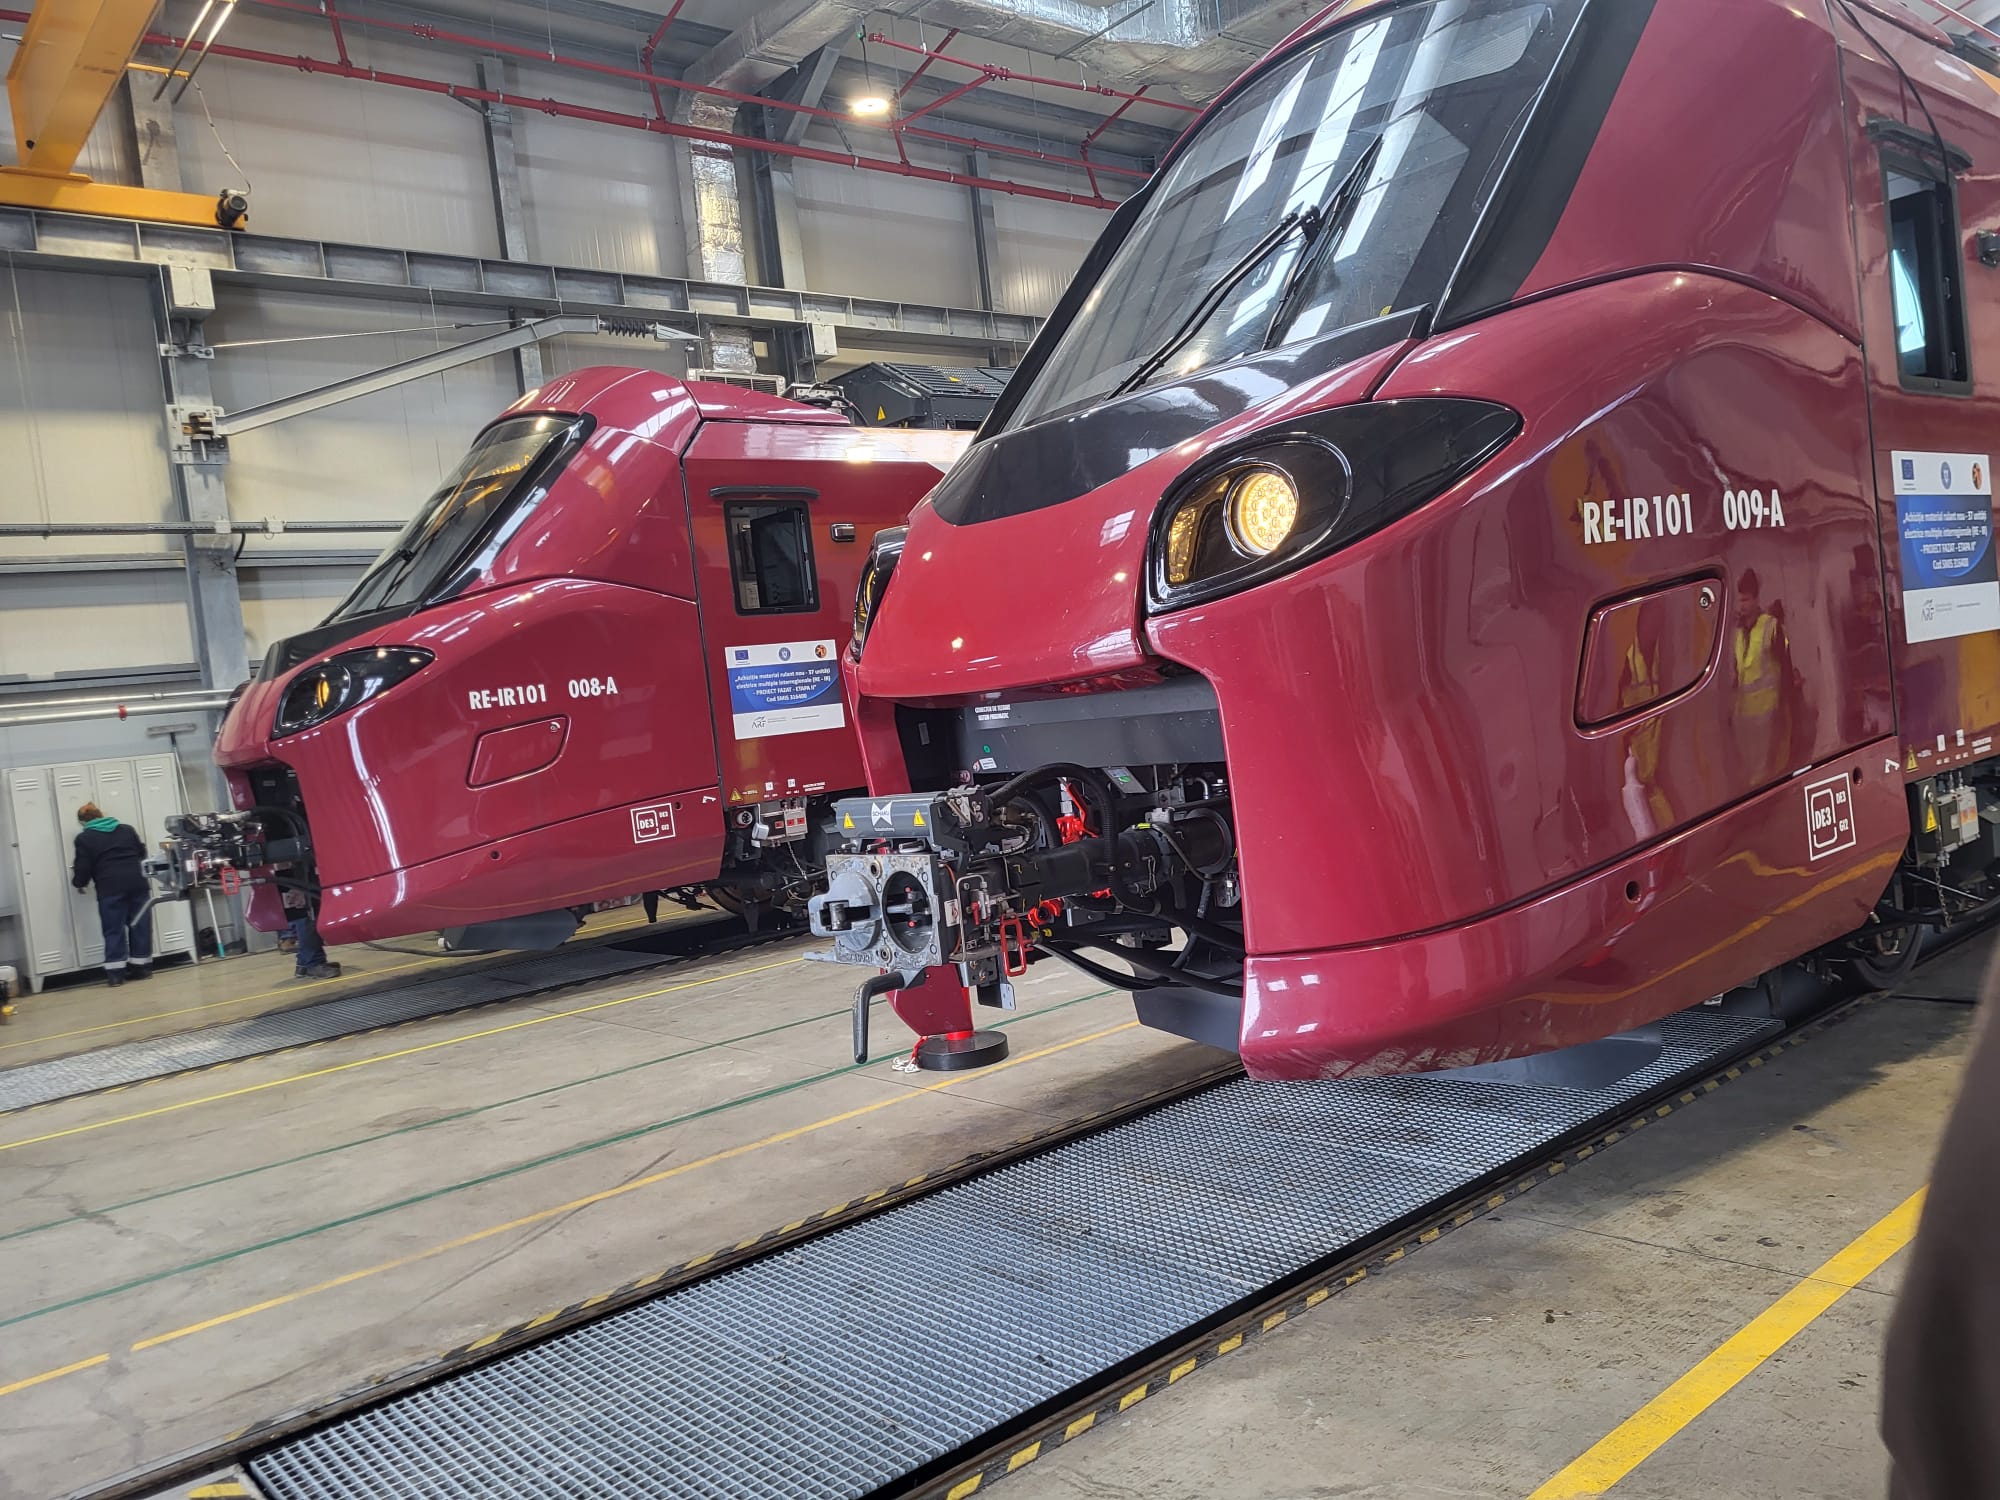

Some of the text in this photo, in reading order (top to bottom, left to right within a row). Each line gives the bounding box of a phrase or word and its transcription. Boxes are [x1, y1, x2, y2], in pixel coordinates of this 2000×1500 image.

[1723, 489, 1785, 530] 009-A
[568, 676, 618, 699] 008-A
[1836, 790, 1846, 804] DE3
[639, 817, 655, 829] DE3
[1815, 805, 1832, 829] DE3
